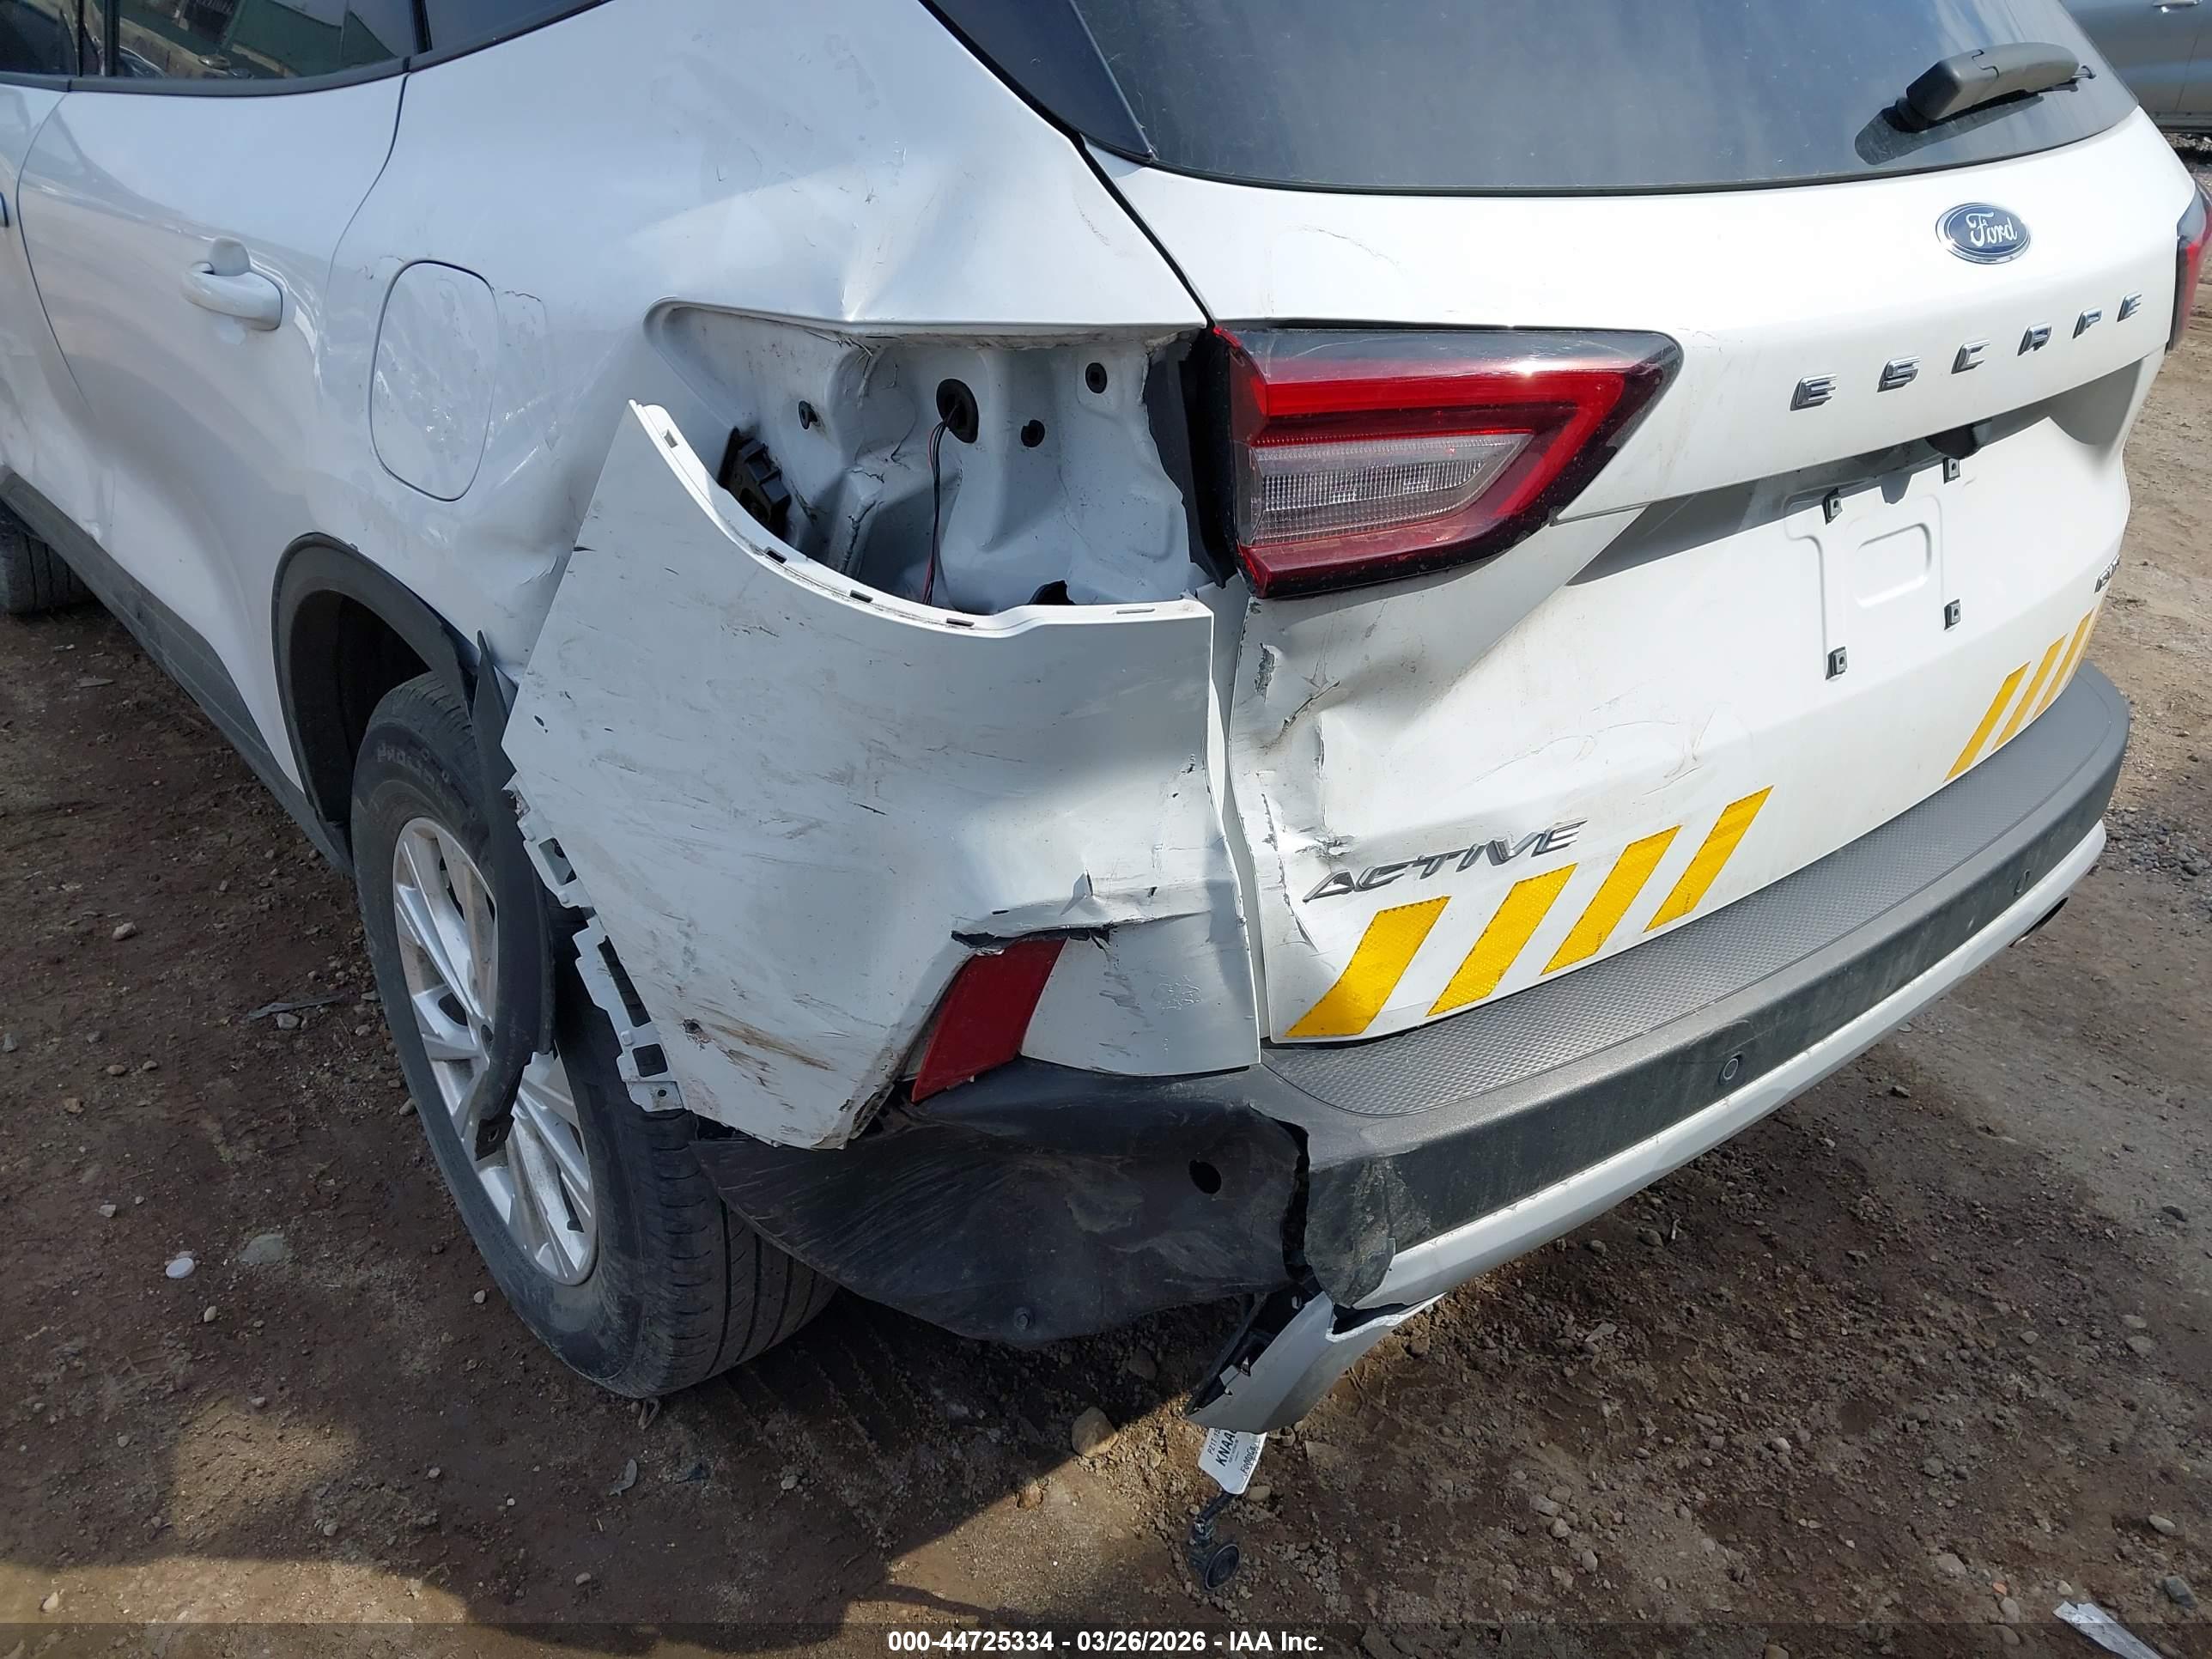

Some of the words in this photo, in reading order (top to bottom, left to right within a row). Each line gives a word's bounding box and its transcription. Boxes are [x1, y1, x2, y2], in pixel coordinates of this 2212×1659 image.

[1966, 211, 2018, 247] Ford
[1790, 291, 2142, 411] ESCAPE
[1302, 817, 1589, 903] ACTIVE
